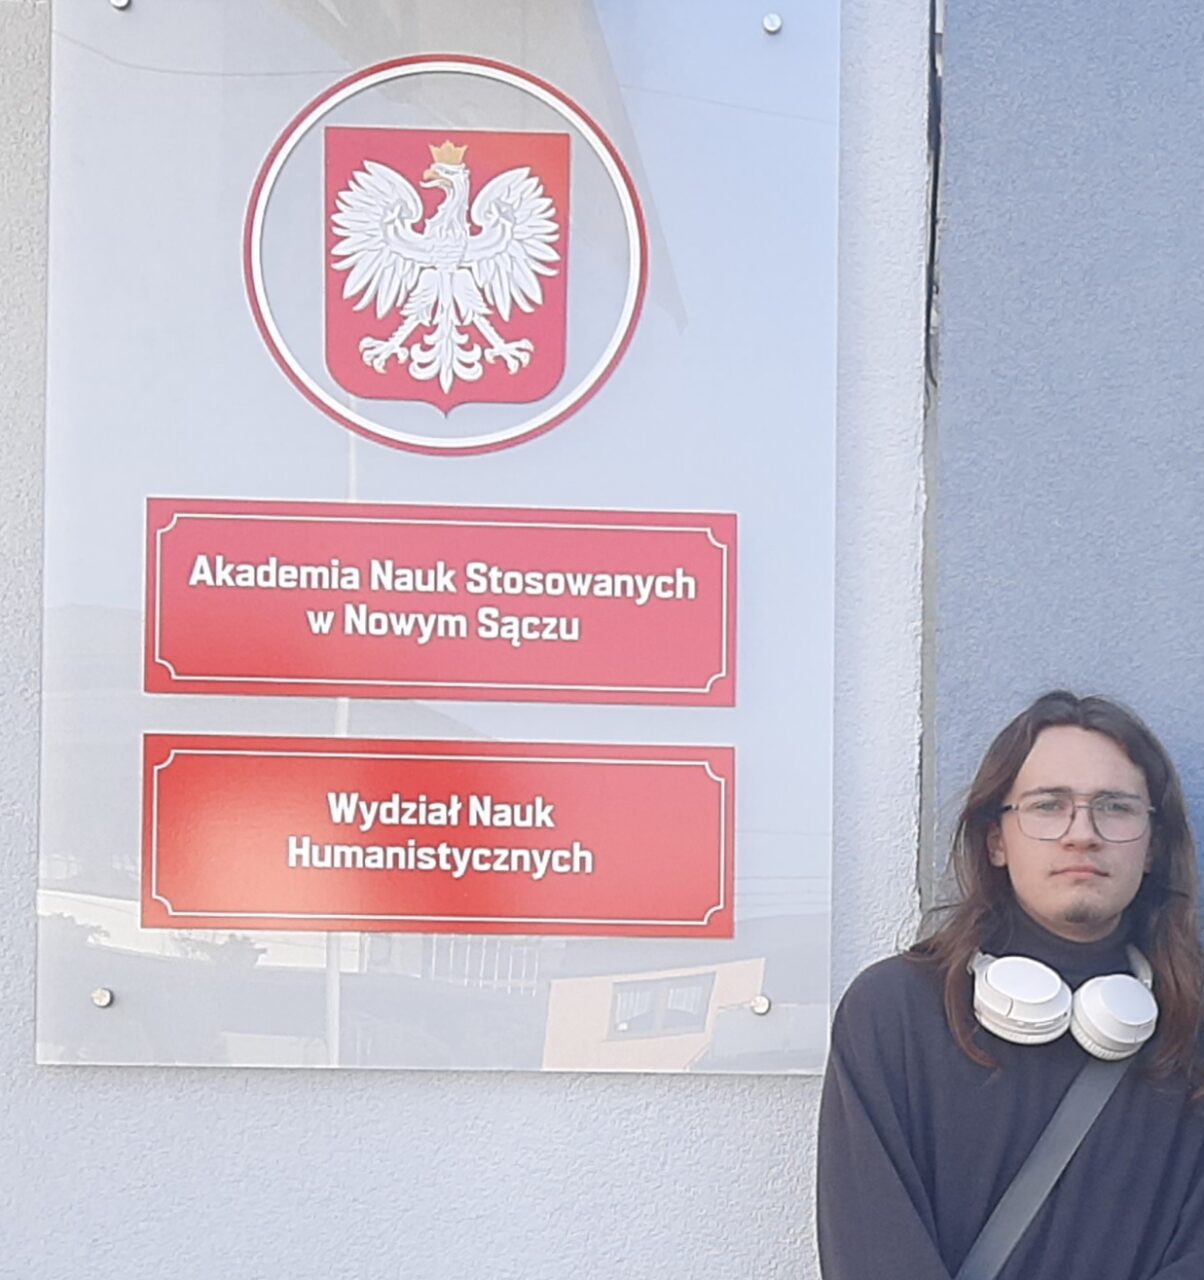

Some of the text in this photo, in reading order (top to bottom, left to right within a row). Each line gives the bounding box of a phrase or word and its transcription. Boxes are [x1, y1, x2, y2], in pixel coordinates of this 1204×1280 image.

[189, 555, 696, 606] Akademia Nauk Stosowanych
[307, 603, 580, 647] w Nowym Sączu
[328, 792, 555, 832] Wydział Nauk
[288, 836, 592, 880] Humanistycznych
